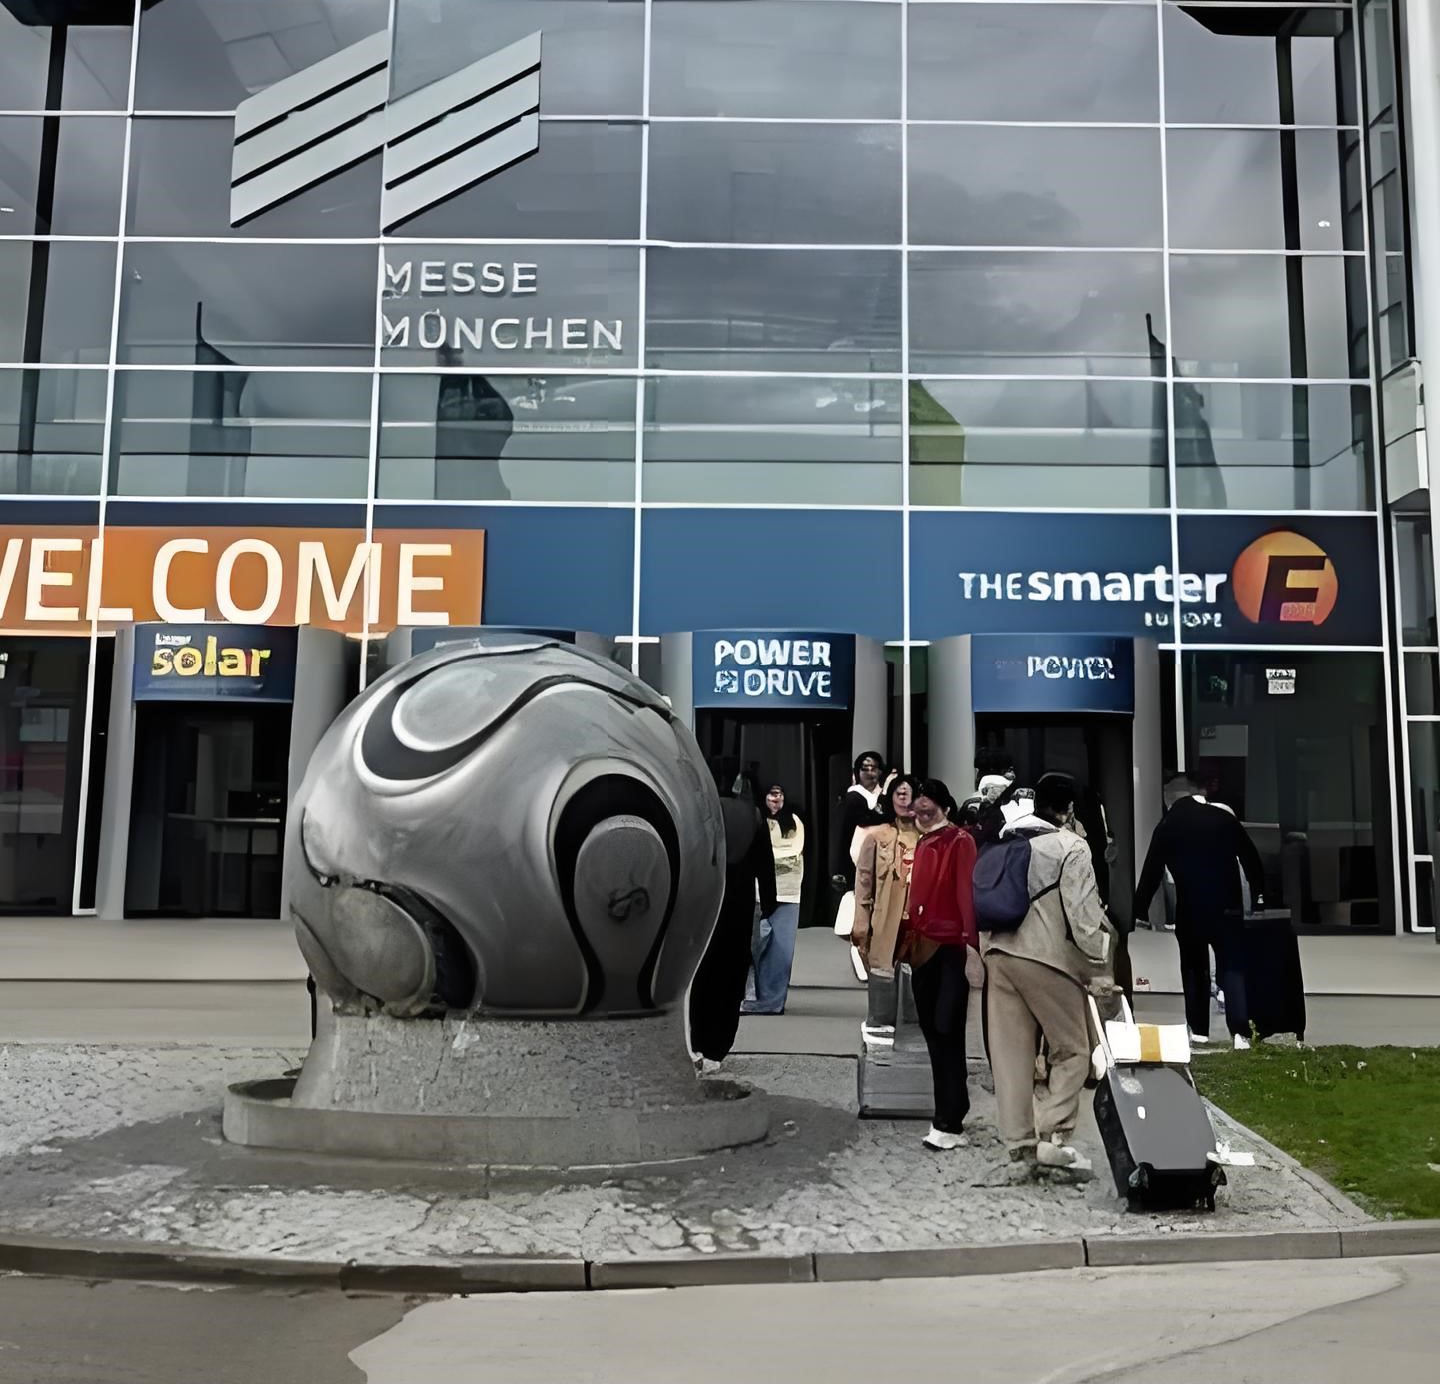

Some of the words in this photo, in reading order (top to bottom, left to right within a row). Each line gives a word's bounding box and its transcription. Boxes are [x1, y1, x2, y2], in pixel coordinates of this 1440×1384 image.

[383, 260, 538, 296] MESSE
[960, 571, 1021, 601] THE
[1029, 565, 1227, 603] smarter
[151, 635, 272, 676] solar
[714, 639, 831, 667] POWER
[744, 670, 831, 698] DRIVE
